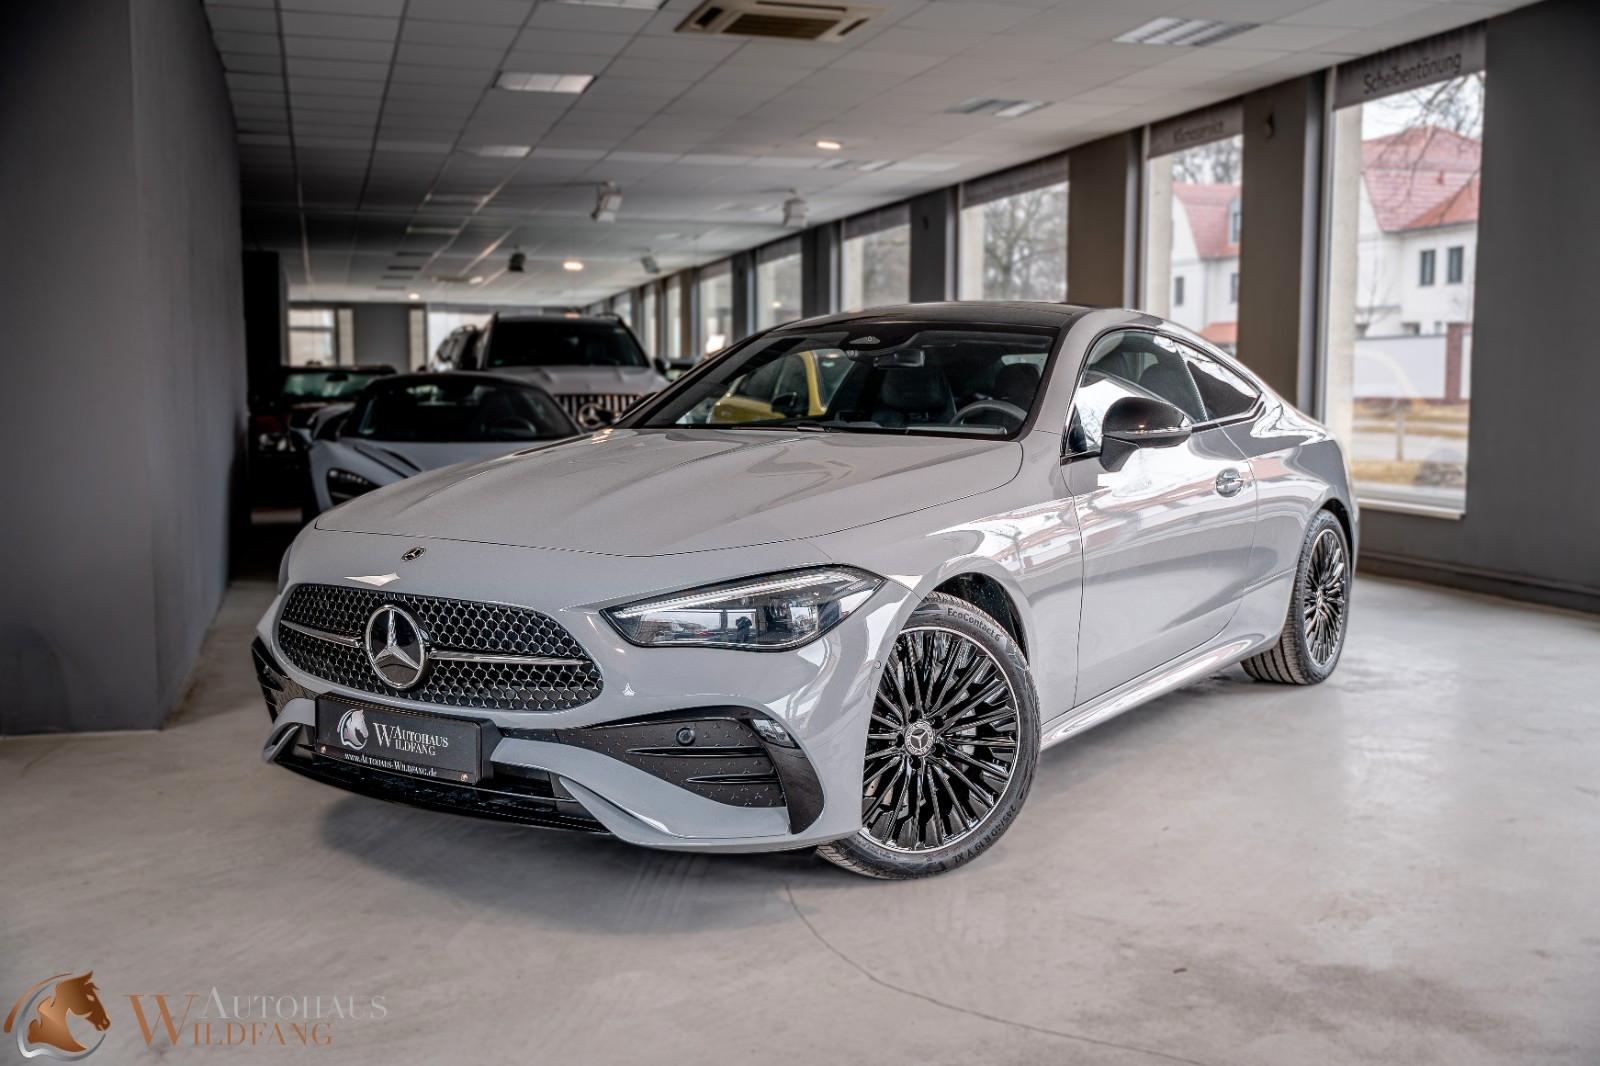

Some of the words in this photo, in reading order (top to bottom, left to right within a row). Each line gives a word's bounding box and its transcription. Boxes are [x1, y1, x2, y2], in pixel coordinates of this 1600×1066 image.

[947, 607, 996, 637] EcoContact
[994, 633, 1001, 642] 6
[373, 722, 437, 756] WILDFANG
[392, 725, 449, 748] AUTOHAUS
